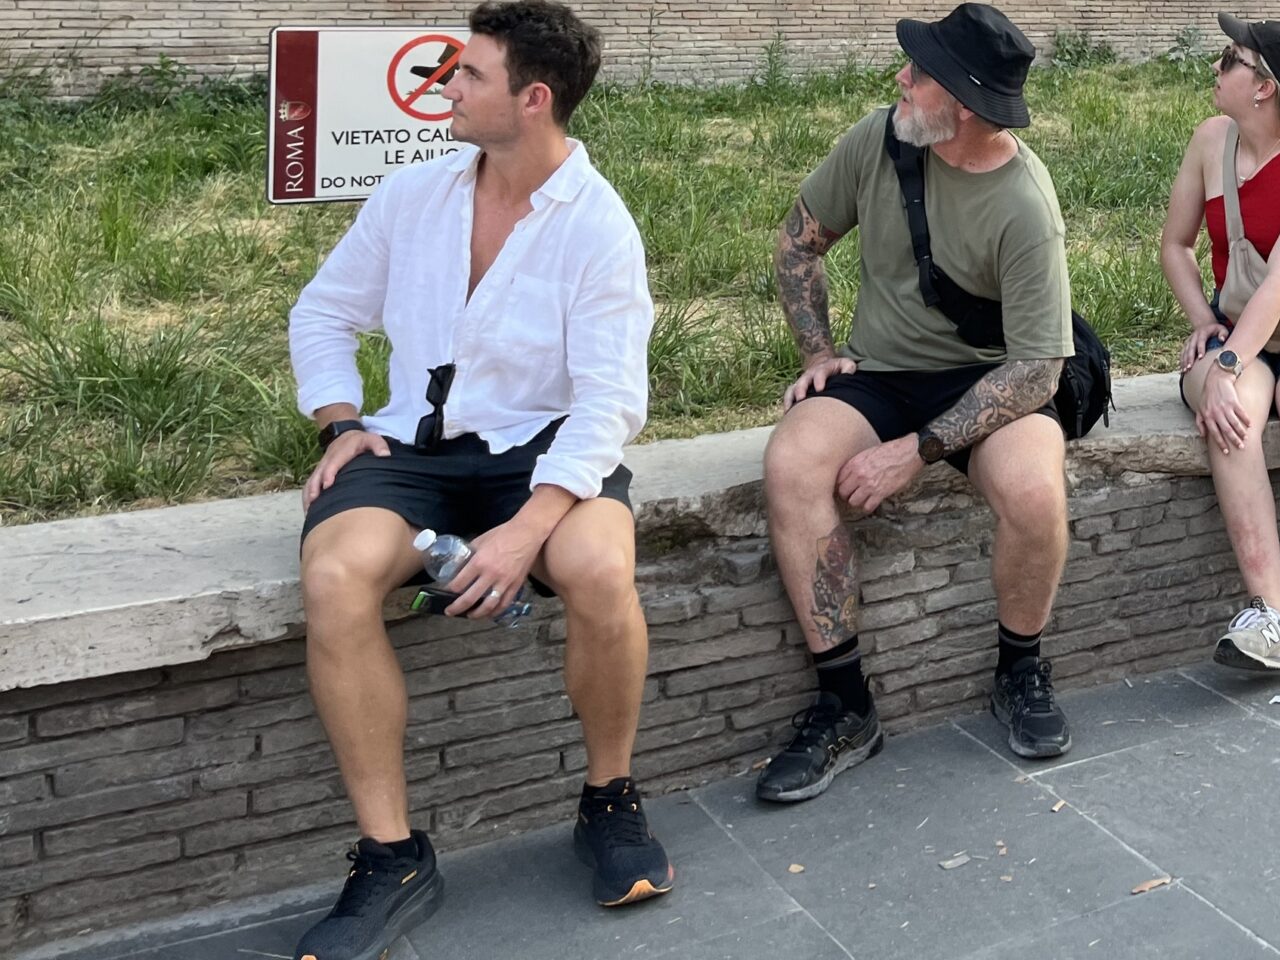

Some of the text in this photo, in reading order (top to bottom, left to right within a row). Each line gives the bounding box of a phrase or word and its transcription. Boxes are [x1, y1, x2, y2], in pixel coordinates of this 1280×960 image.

[331, 128, 411, 145] VIETATO
[285, 125, 305, 192] ROMA
[384, 150, 405, 164] LE
[321, 174, 384, 189] DO NOT
[1261, 622, 1280, 648] N
